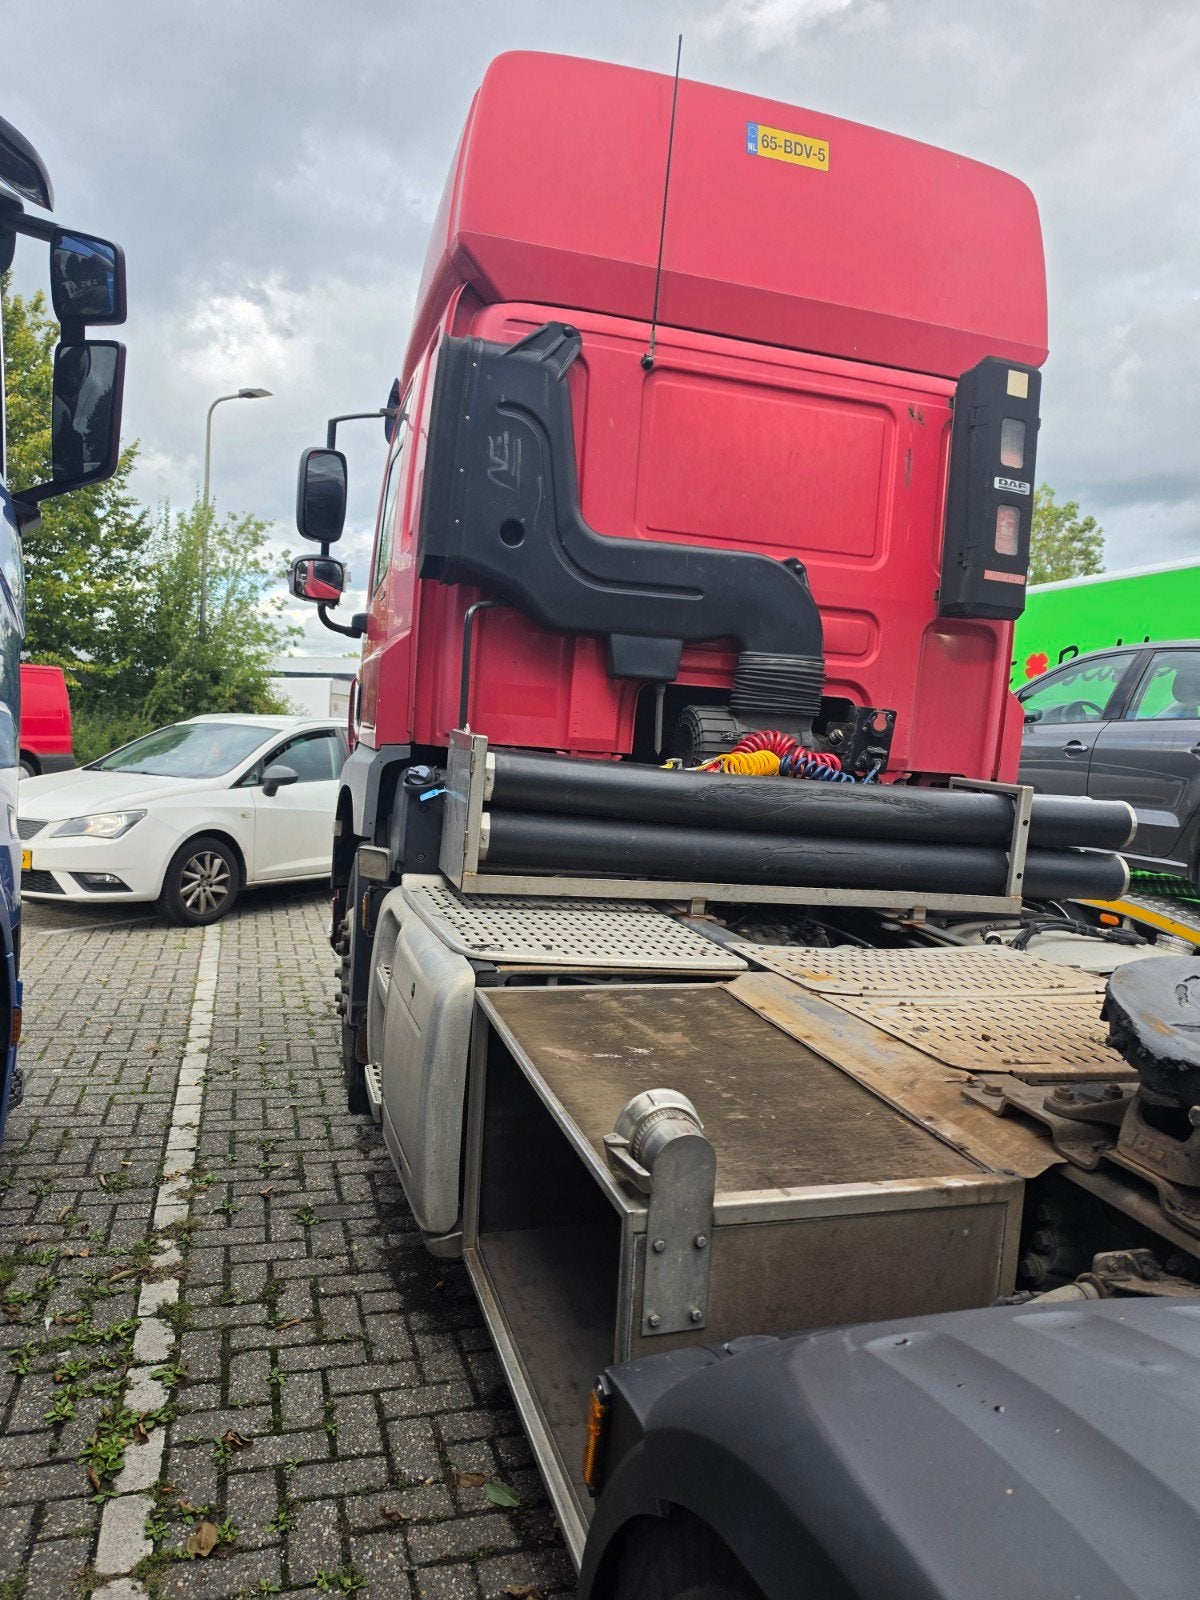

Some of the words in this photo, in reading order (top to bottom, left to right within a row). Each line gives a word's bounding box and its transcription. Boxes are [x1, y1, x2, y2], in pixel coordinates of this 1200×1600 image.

[748, 142, 757, 152] NL
[761, 134, 826, 162] 65-BDV-5
[998, 478, 1027, 489] DAF
